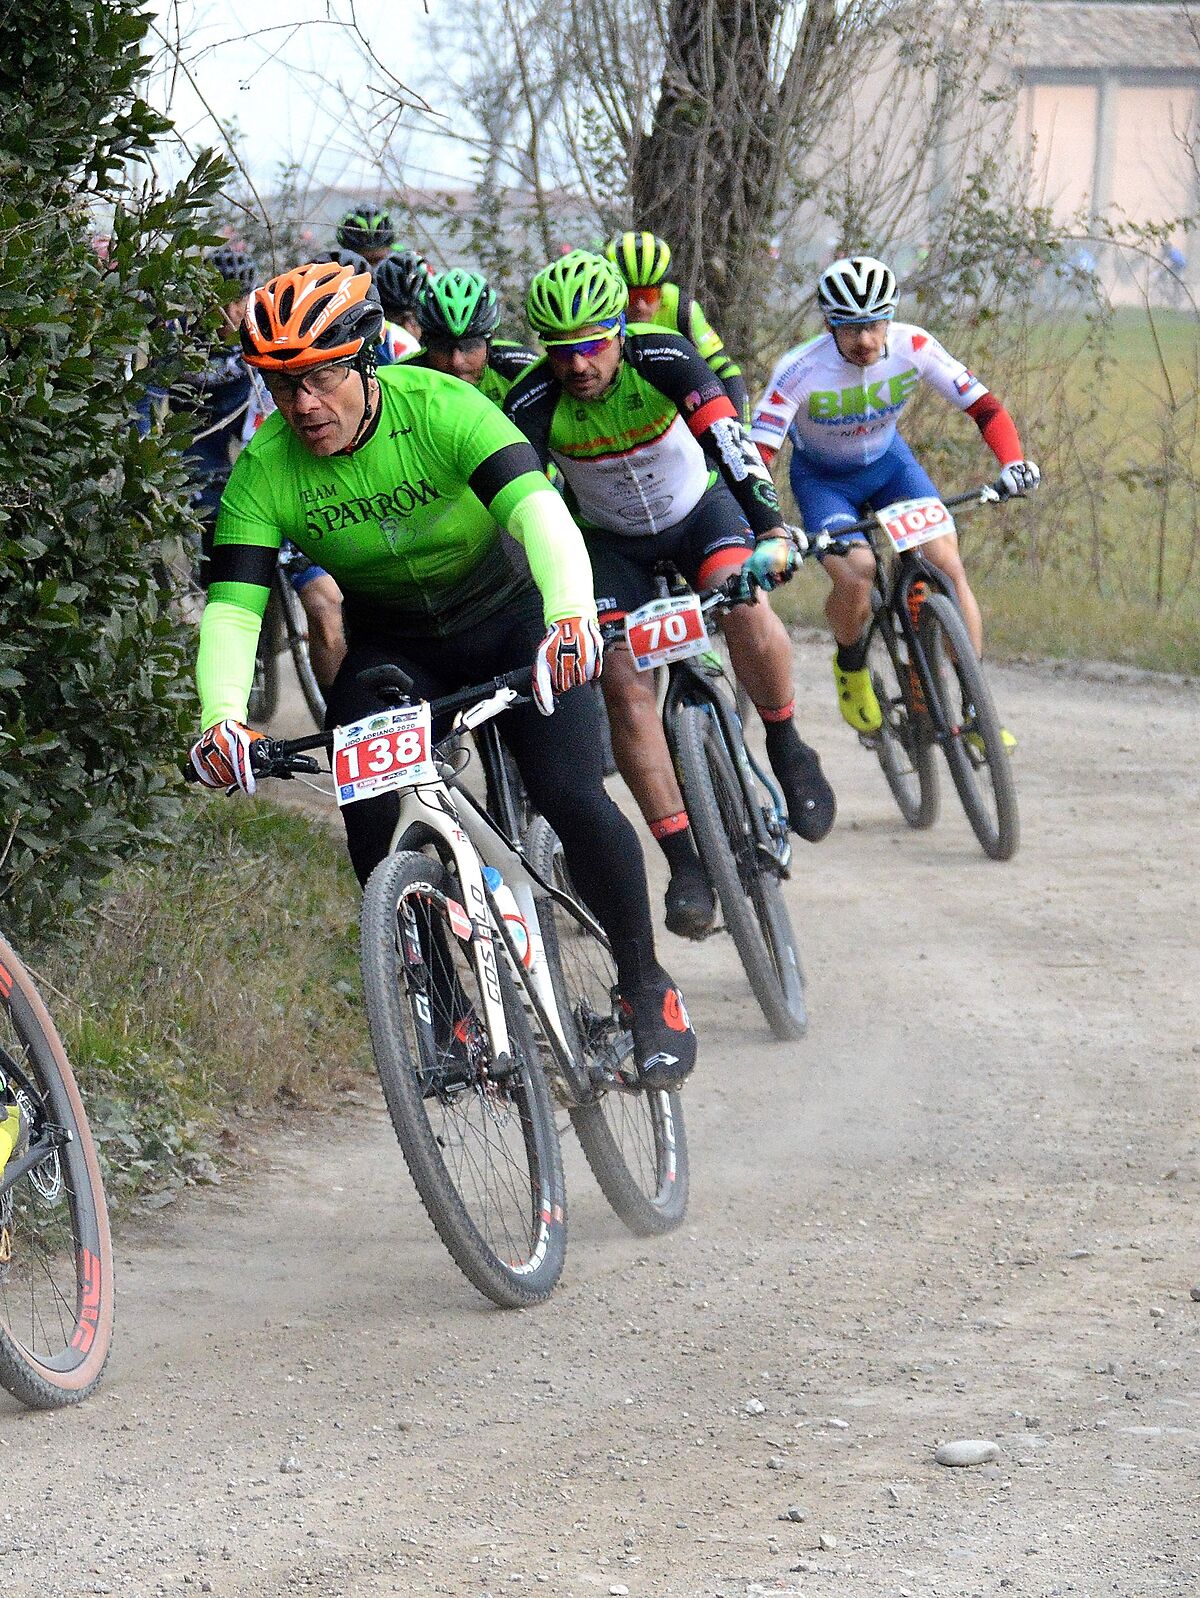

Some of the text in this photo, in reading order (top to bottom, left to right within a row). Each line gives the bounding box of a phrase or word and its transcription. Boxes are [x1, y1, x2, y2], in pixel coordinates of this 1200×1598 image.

[808, 367, 918, 419] BIKE
[306, 479, 442, 541] SPARROW
[887, 505, 944, 536] 106
[643, 614, 687, 650] 70
[342, 730, 422, 780] 138
[345, 723, 416, 748] LIDO ADRIANO 2020
